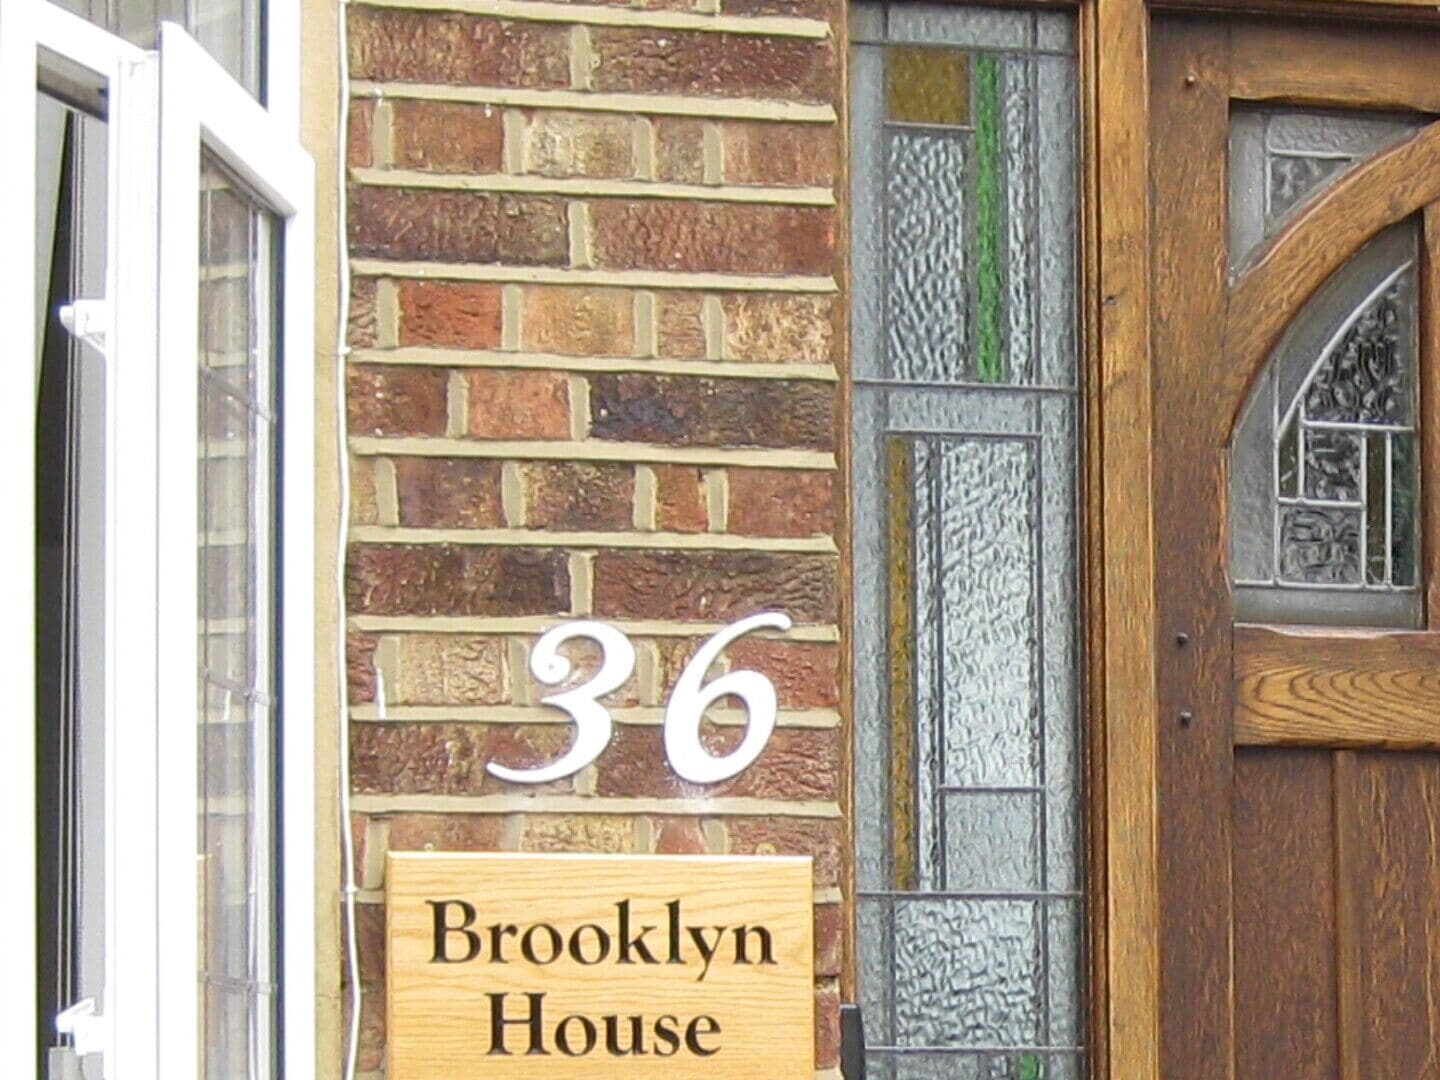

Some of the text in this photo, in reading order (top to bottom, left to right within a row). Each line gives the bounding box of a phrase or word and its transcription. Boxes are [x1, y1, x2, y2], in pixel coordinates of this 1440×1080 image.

[486, 613, 792, 783] 36
[425, 899, 778, 981] Brooklyn
[485, 992, 722, 1056] House
